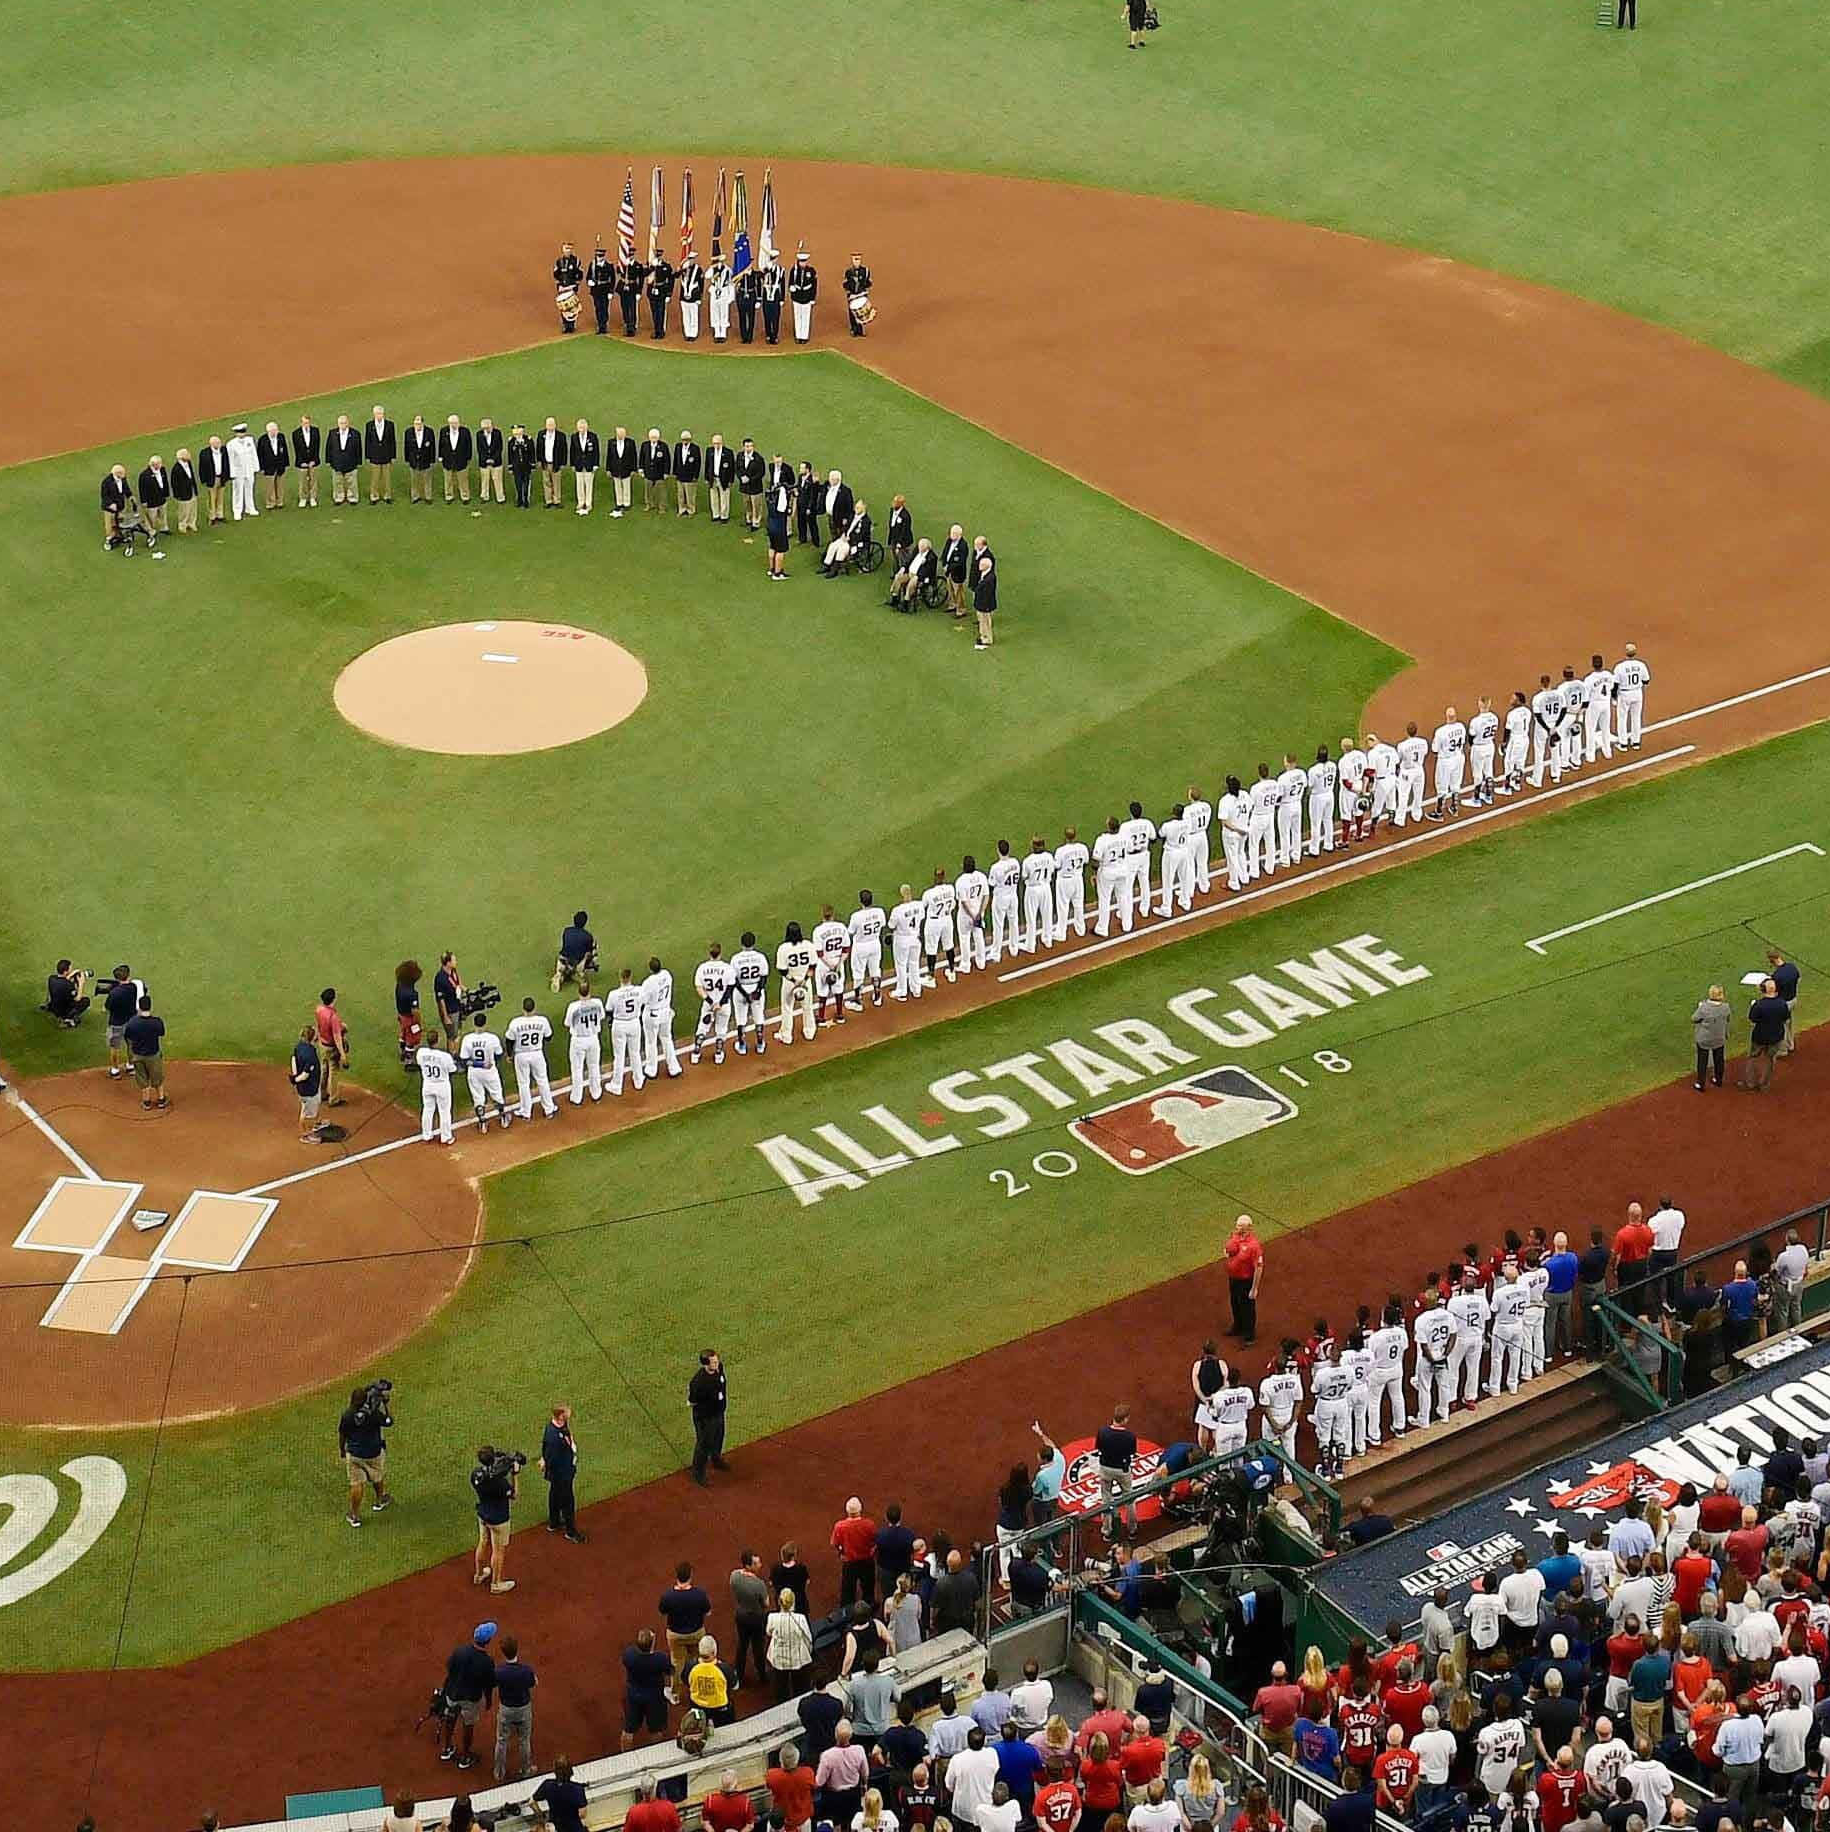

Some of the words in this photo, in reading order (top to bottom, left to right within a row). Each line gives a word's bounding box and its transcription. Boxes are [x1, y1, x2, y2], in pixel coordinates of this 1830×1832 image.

[825, 937, 843, 952] 62
[787, 952, 810, 968] 35
[740, 966, 760, 980] 22
[704, 977, 724, 992] 34
[580, 1013, 599, 1029] 44
[520, 1032, 539, 1047] 28
[756, 1103, 961, 1207] ALL
[928, 1017, 1201, 1138] STAR
[1168, 934, 1433, 1049] GAME
[1432, 1325, 1449, 1341] 29
[1051, 1804, 1071, 1821] 37
